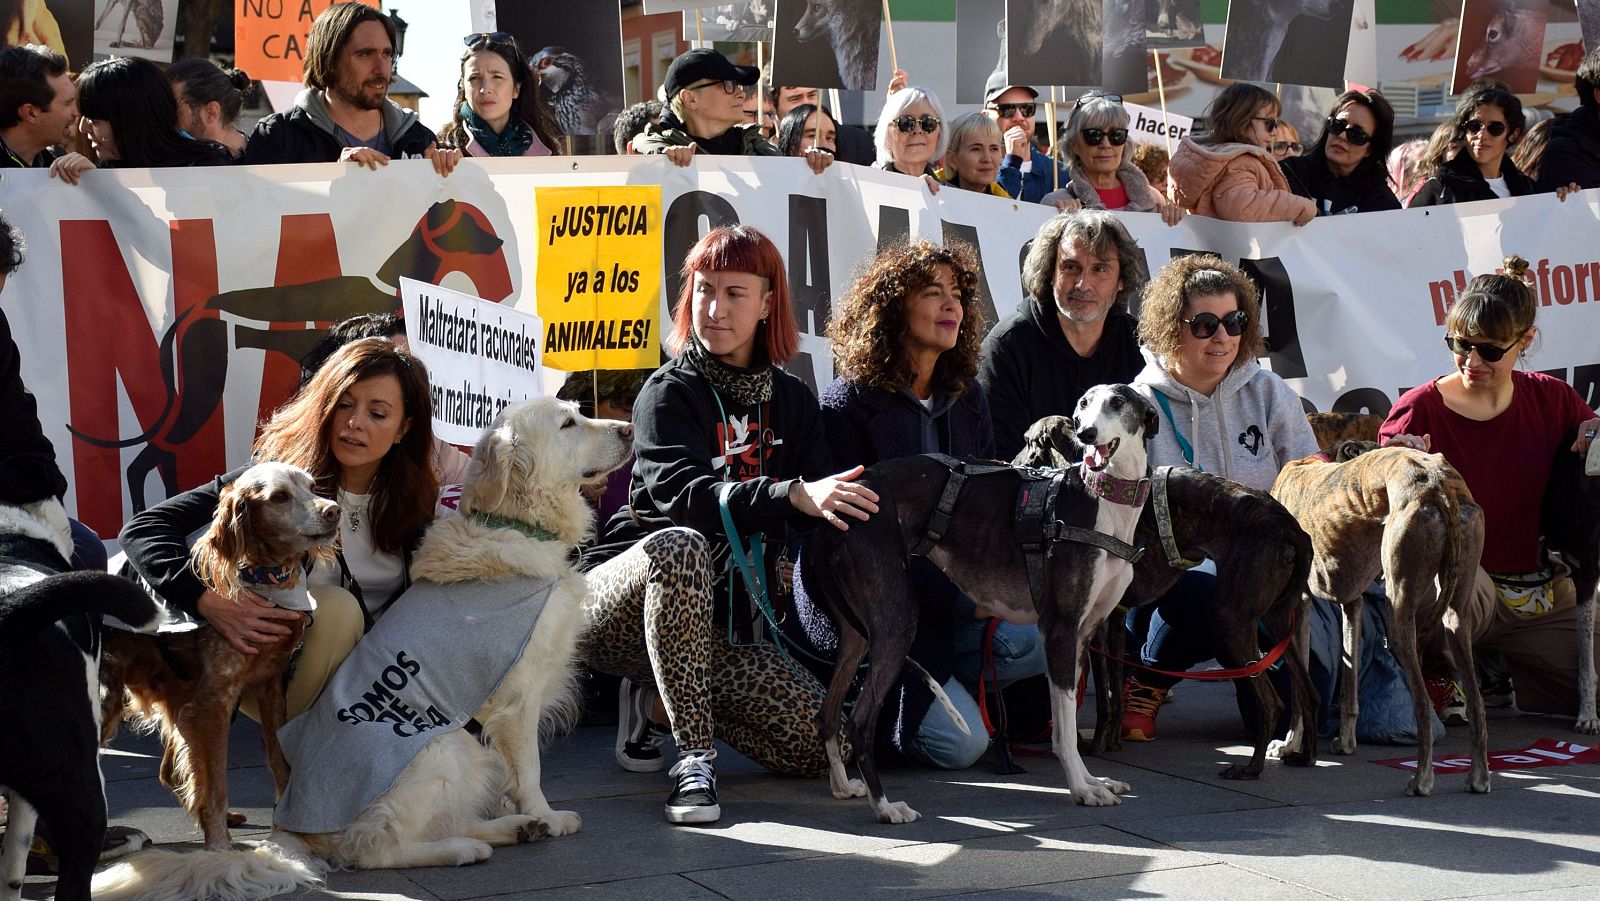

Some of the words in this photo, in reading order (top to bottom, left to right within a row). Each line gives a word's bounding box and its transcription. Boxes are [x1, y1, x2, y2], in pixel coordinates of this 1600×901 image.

[242, 0, 283, 19] NO
[298, 0, 314, 22] A
[1135, 112, 1187, 140] hacer
[549, 205, 648, 246] ¡JUSTICIA
[563, 271, 588, 303] ya
[593, 269, 606, 293] a
[610, 263, 640, 293] los
[419, 293, 478, 356] Maltratará
[480, 316, 536, 372] racionales
[544, 318, 651, 354] ANIMALES!
[445, 379, 493, 429] maltrata
[337, 650, 421, 726] SOMOS
